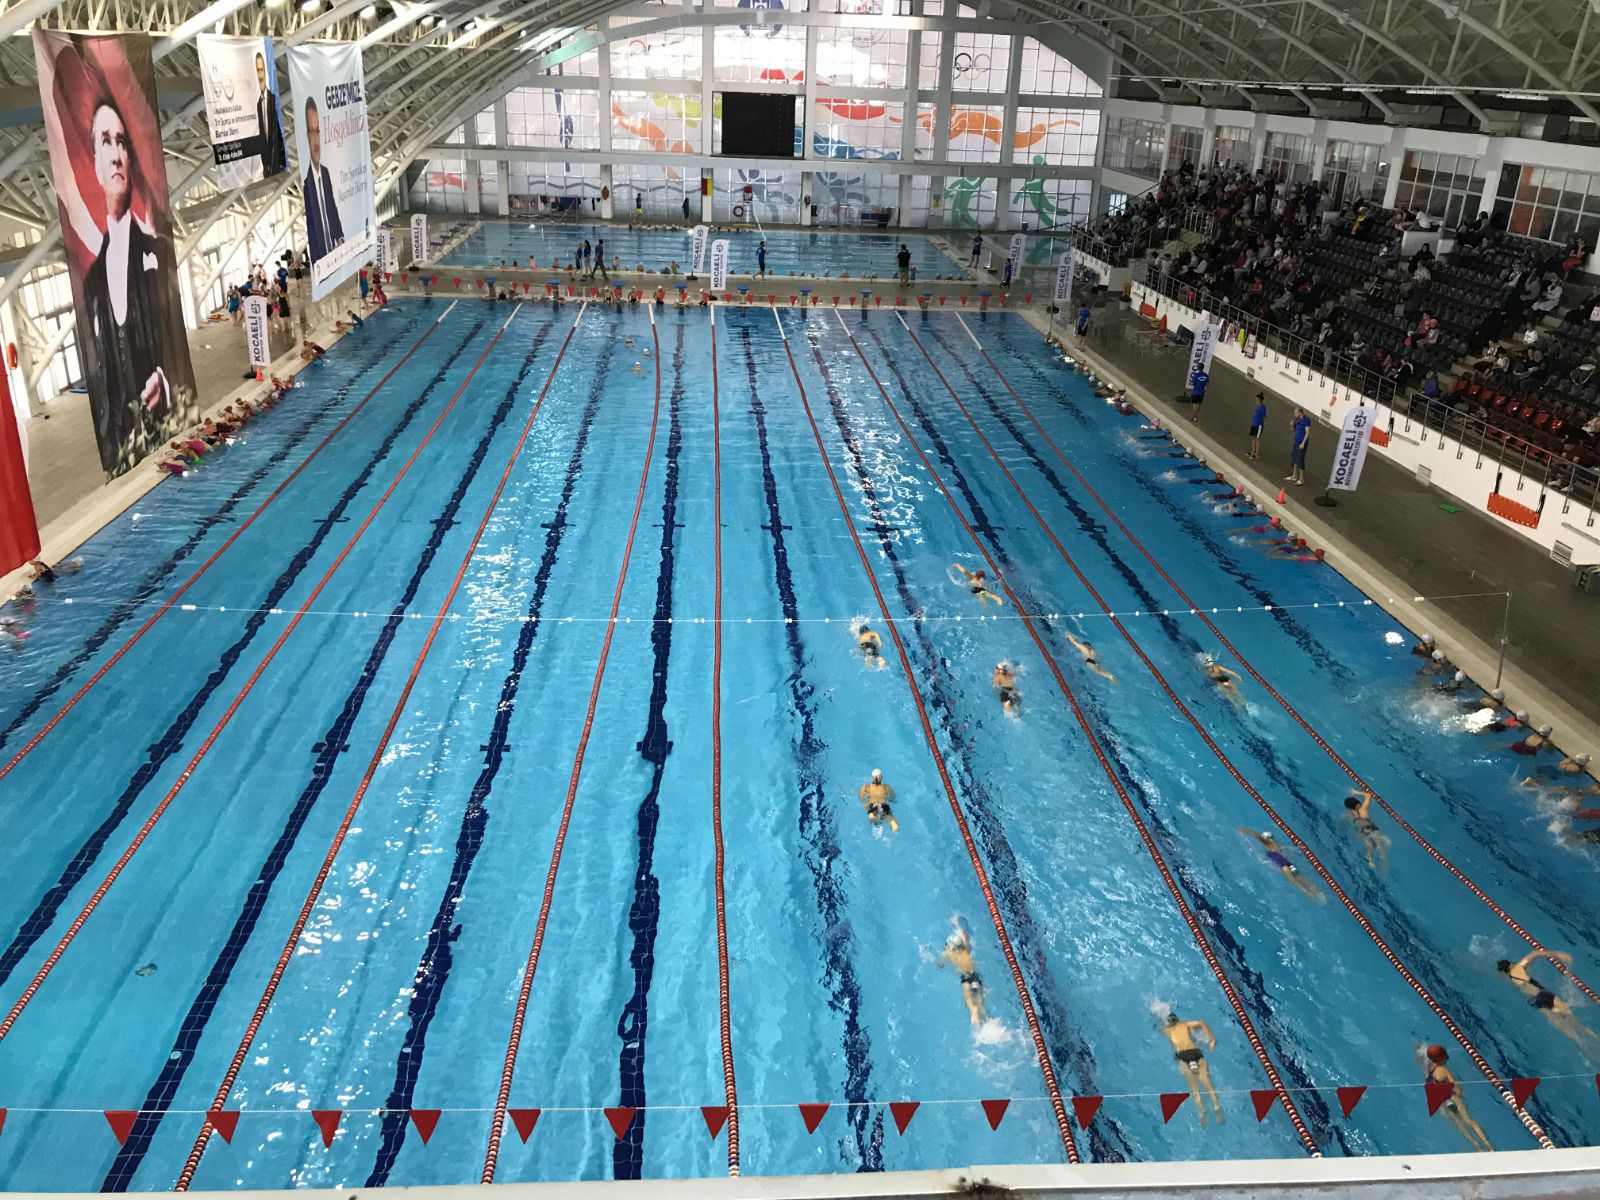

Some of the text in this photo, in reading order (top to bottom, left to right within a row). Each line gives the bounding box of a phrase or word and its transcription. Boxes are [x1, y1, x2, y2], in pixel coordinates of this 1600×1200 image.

[1057, 265, 1067, 299] KOCAELİ
[248, 315, 261, 362] KOCAELİ
[1333, 429, 1357, 485] KOCAELİ
